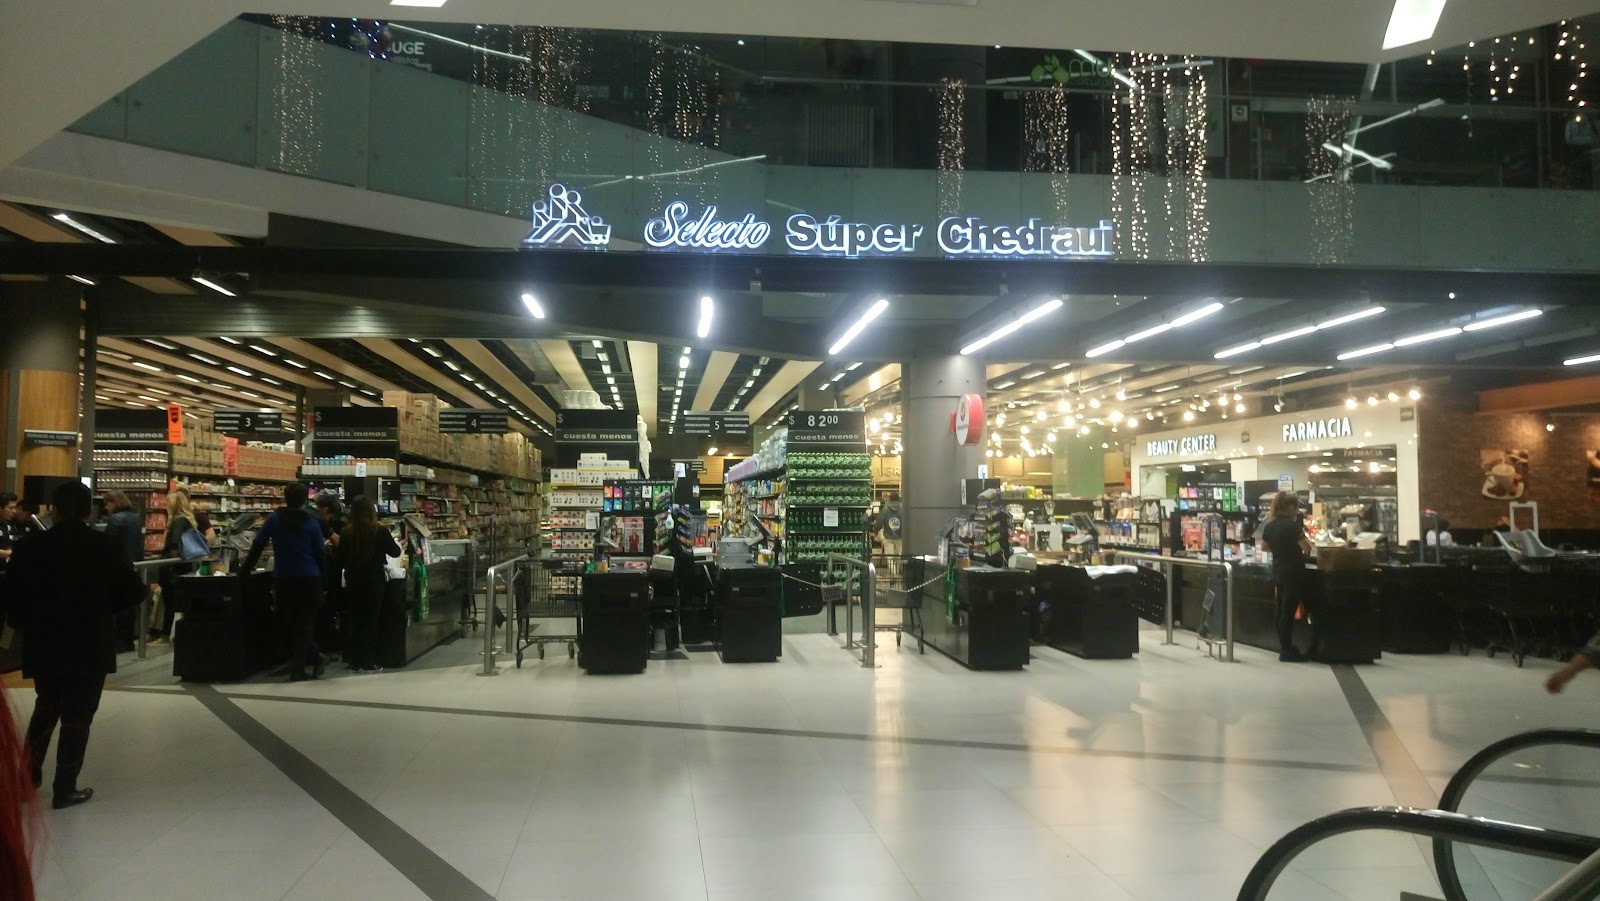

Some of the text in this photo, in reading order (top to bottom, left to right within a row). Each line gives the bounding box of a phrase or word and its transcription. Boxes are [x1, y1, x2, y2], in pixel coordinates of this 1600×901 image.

[644, 200, 1114, 257] Selecto Súper Chedraui
[245, 417, 251, 428] 3
[470, 418, 477, 428] 4
[557, 414, 564, 424] $
[788, 415, 795, 426] $
[714, 420, 720, 430] 5
[1282, 416, 1352, 443] FARMACIA
[129, 431, 164, 439] menos
[317, 429, 387, 438] cuesta menos
[563, 432, 632, 440] cuesta menos
[828, 433, 859, 441] menos
[1147, 434, 1217, 456] BEAUTY CENTER
[1344, 448, 1384, 458] FARMACIA
[1237, 486, 1244, 500] 8
